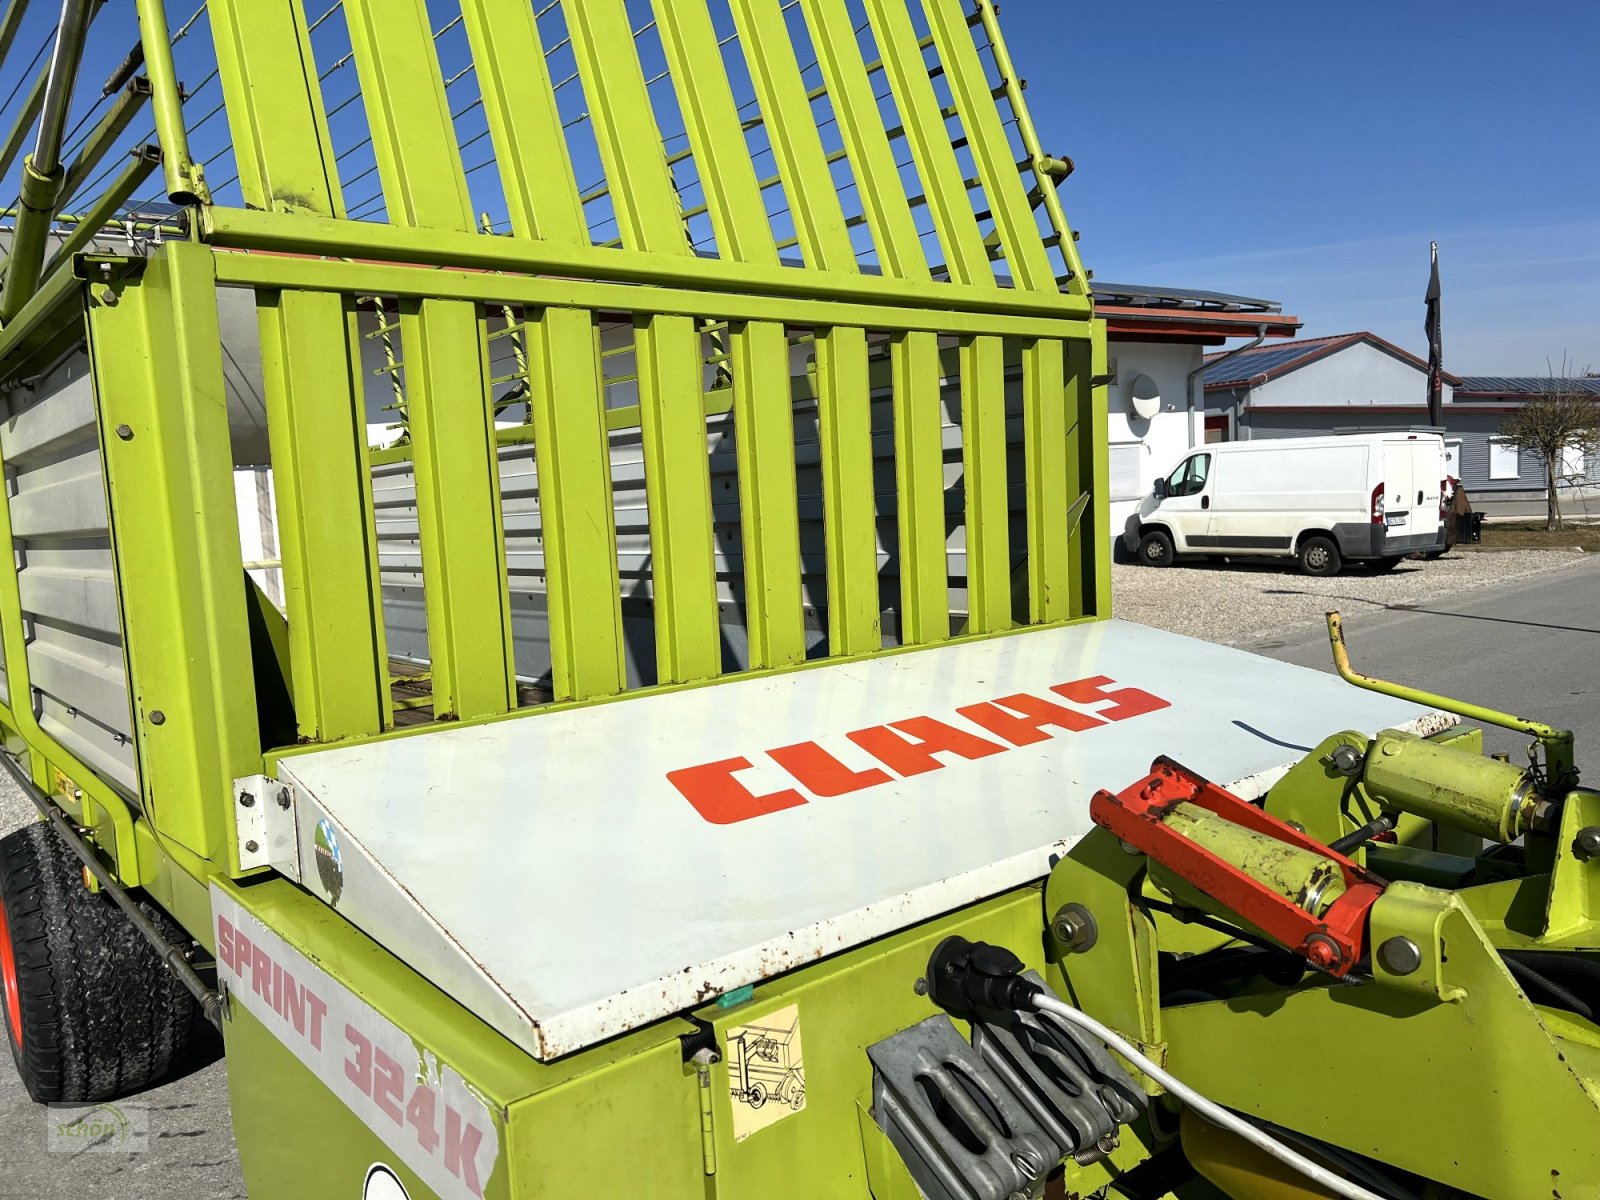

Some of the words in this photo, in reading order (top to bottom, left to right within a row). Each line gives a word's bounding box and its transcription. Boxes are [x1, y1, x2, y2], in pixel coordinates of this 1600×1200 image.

[666, 675, 1171, 824] CLAAS
[218, 914, 327, 1052] SPRINT
[344, 1023, 483, 1200] 324K
